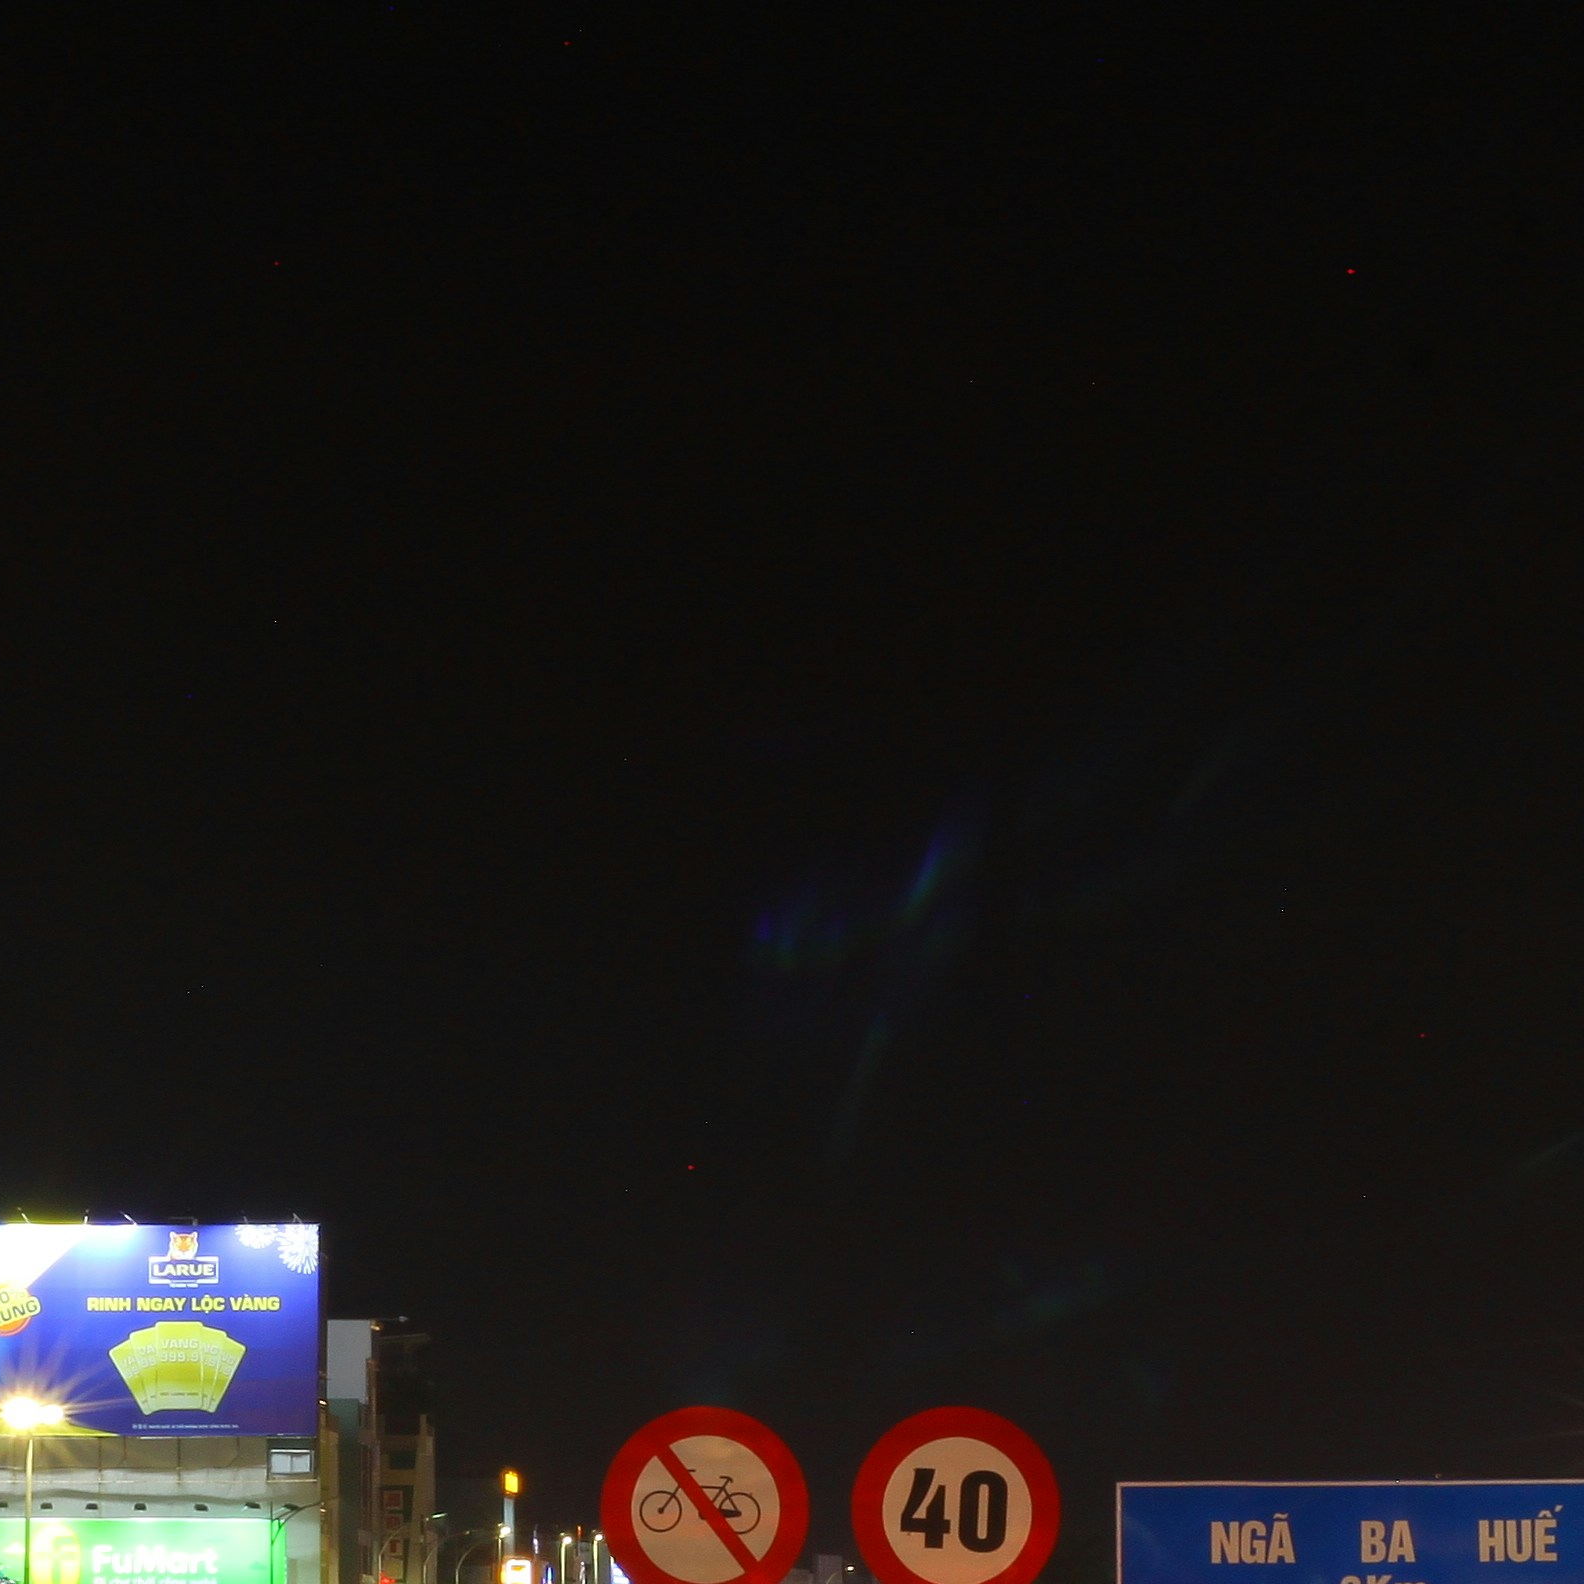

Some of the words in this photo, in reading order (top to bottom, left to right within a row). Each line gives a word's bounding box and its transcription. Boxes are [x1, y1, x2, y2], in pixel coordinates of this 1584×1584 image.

[152, 1263, 216, 1277] LARUE
[86, 1296, 132, 1312] RINH
[136, 1296, 187, 1312] NGAY
[191, 1294, 226, 1315] LỘC
[230, 1293, 282, 1312] VÀNG
[900, 1467, 1009, 1553] 40
[1210, 1513, 1296, 1564] NGÃ
[1360, 1519, 1417, 1563] BA
[1477, 1504, 1564, 1563] HUẾ
[92, 1544, 220, 1574] FuMart
